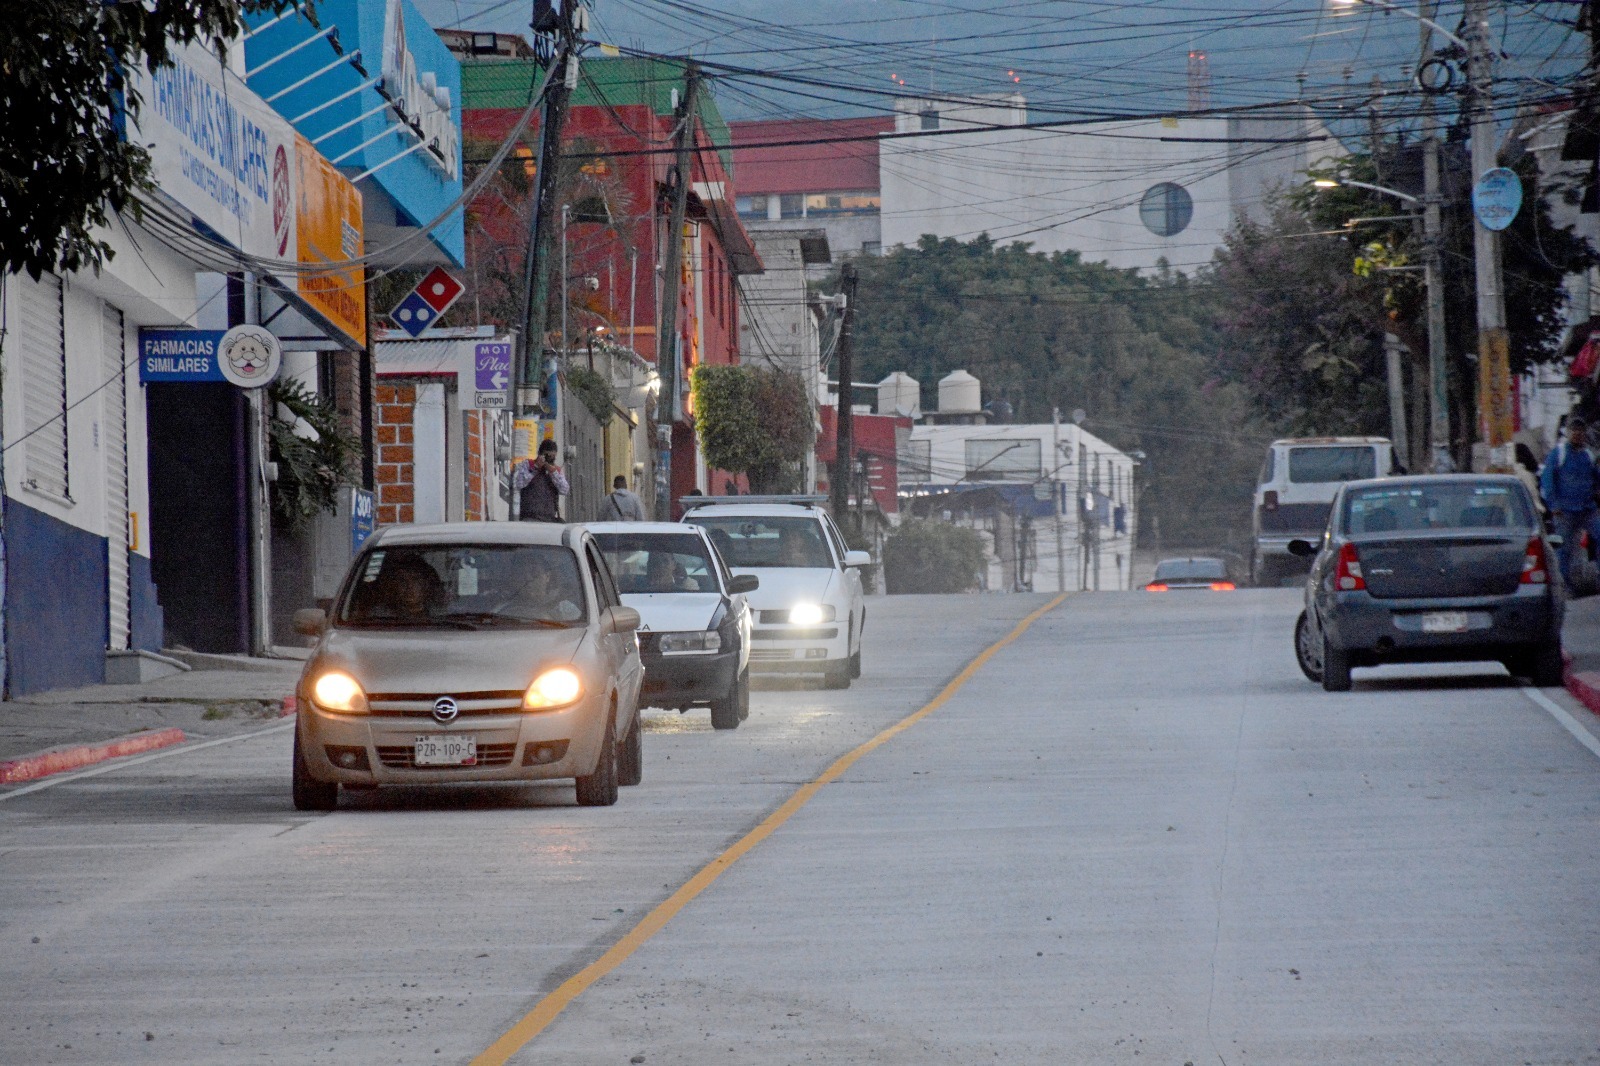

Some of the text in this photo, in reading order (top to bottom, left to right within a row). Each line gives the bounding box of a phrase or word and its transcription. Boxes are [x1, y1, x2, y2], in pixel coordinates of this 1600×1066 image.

[215, 90, 269, 205] SIMILARES
[145, 341, 214, 355] FARMACIAS
[480, 346, 508, 355] MOT
[147, 358, 209, 373] SIMILARES
[476, 396, 504, 406] Campo
[357, 494, 372, 518] 300
[417, 743, 474, 757] PZR-109-C
